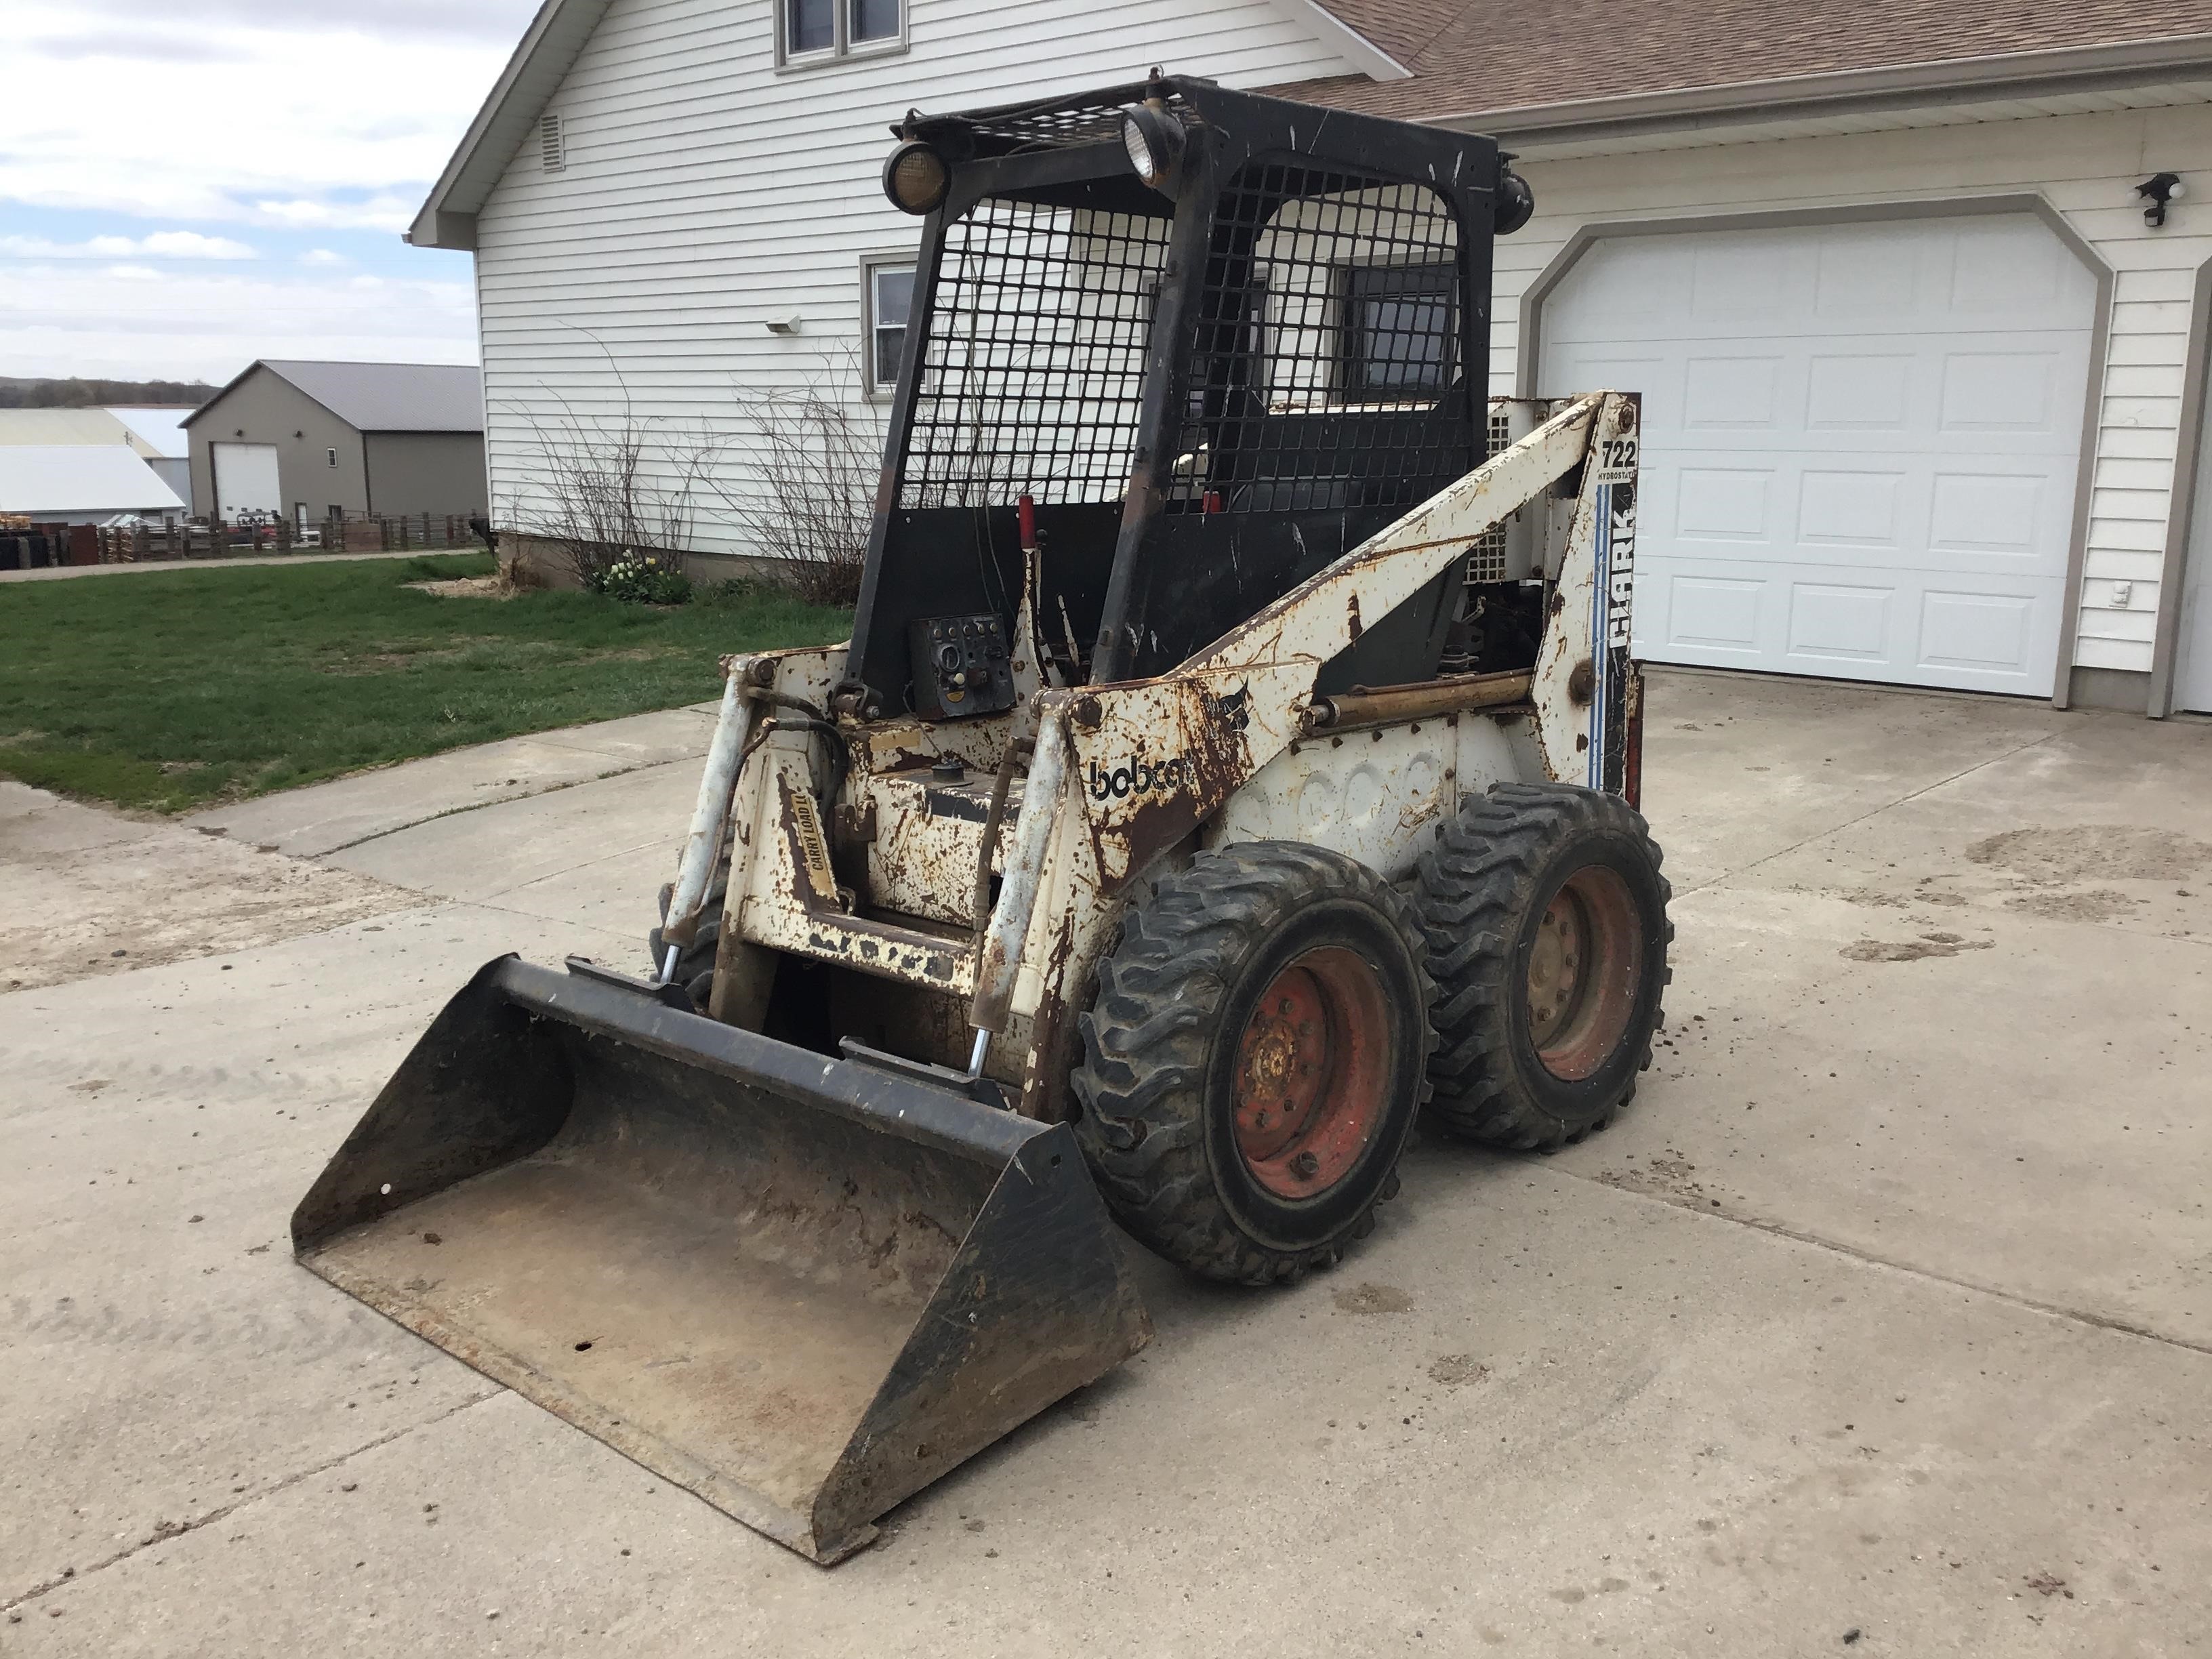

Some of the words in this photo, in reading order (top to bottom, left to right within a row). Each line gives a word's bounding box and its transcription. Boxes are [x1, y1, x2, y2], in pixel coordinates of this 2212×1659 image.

[1602, 441, 1636, 468] 722
[1610, 508, 1636, 649] CLARK
[798, 806, 815, 834] LOAD
[804, 835, 823, 871] CARRY
